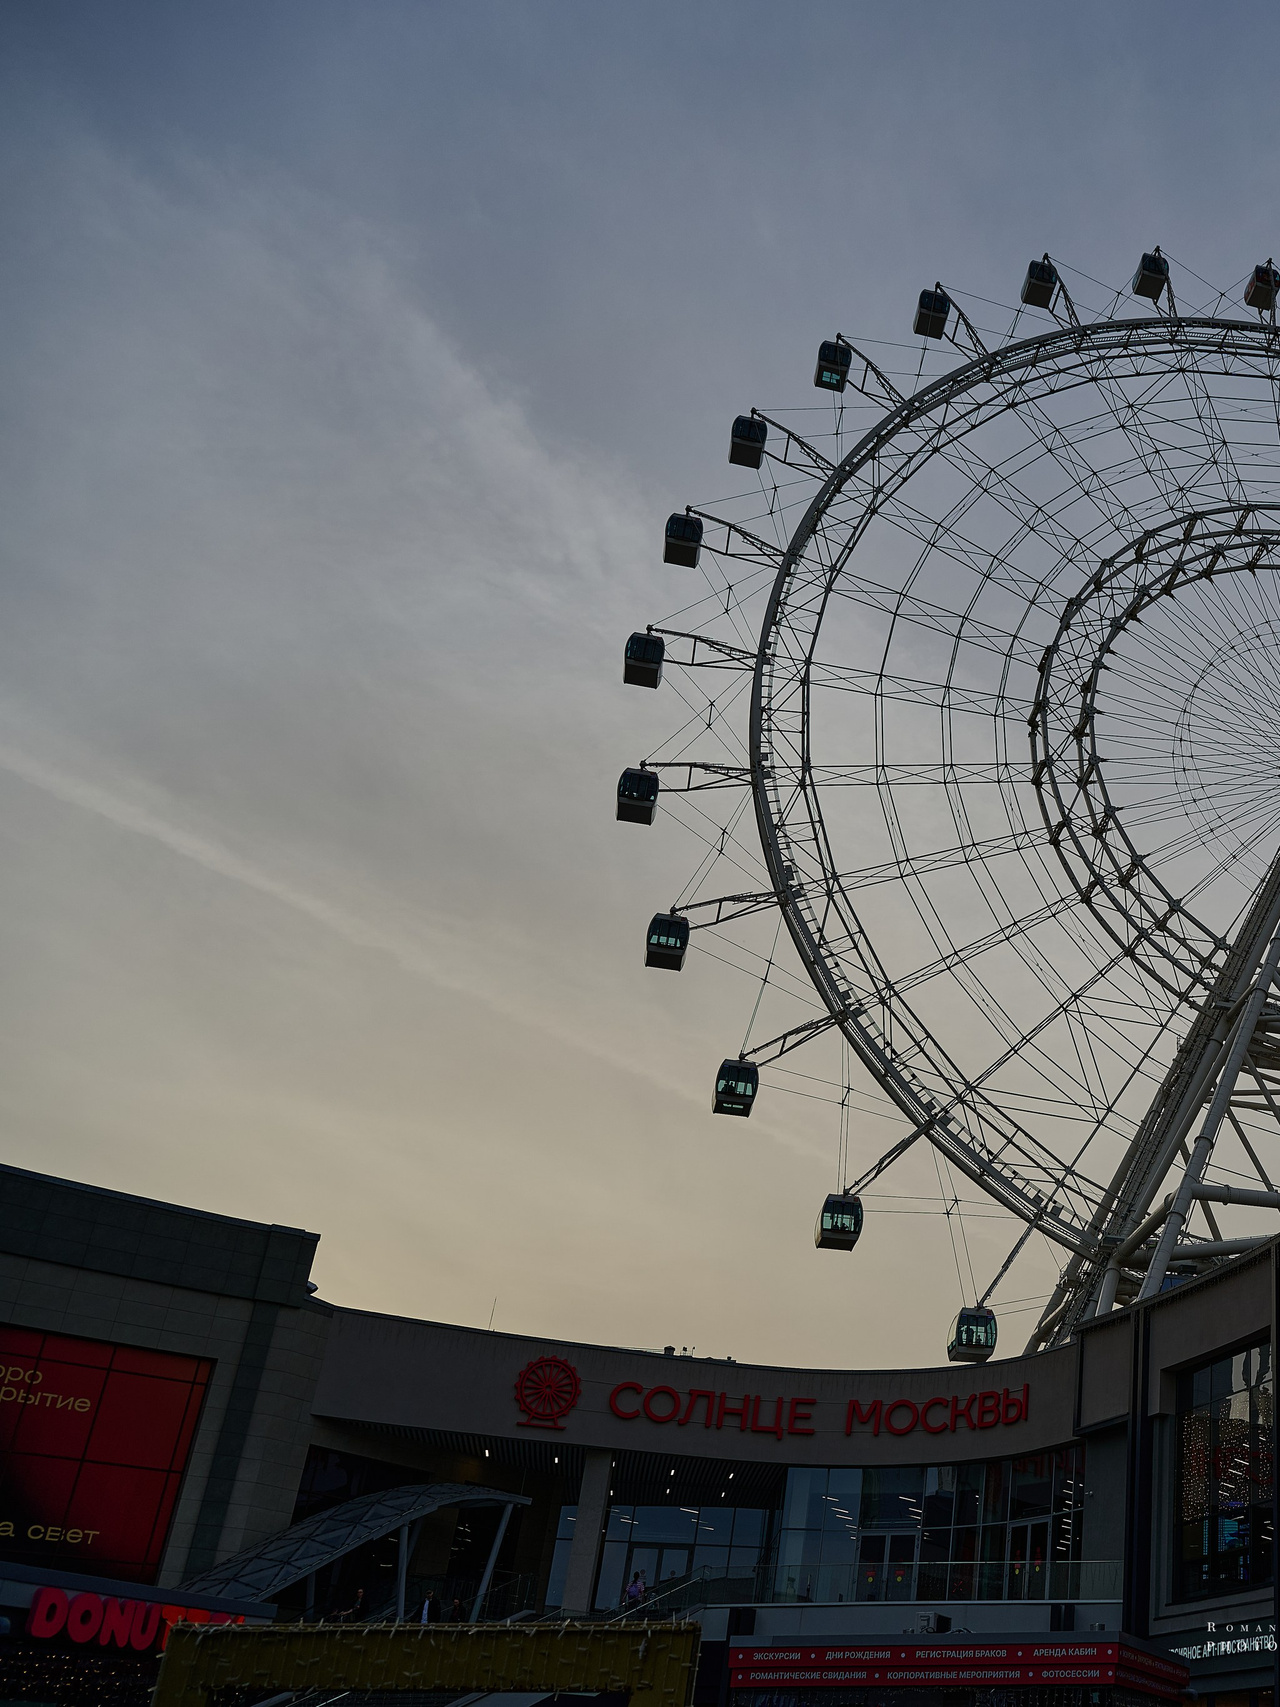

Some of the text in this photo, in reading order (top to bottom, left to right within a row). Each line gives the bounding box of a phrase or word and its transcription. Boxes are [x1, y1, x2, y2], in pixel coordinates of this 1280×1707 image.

[609, 1381, 1030, 1440] СОЛНЦЕ МОСКВЫ
[27, 1524, 101, 1545] свет
[753, 1647, 1097, 1661] ЭКСКУРСИИ ДНИ РОЖДЕНИЯ РЕГИСТРАЦИЯ БРАКОВ АРЕНДА КАБИН
[750, 1669, 1100, 1681] РОМАНТИЧЕСКИЕ СВИДАНИЯ КОРПОРАТИВНЫЕ МЕРОПРИЯТИЯ ФОТОСЕССИИ
